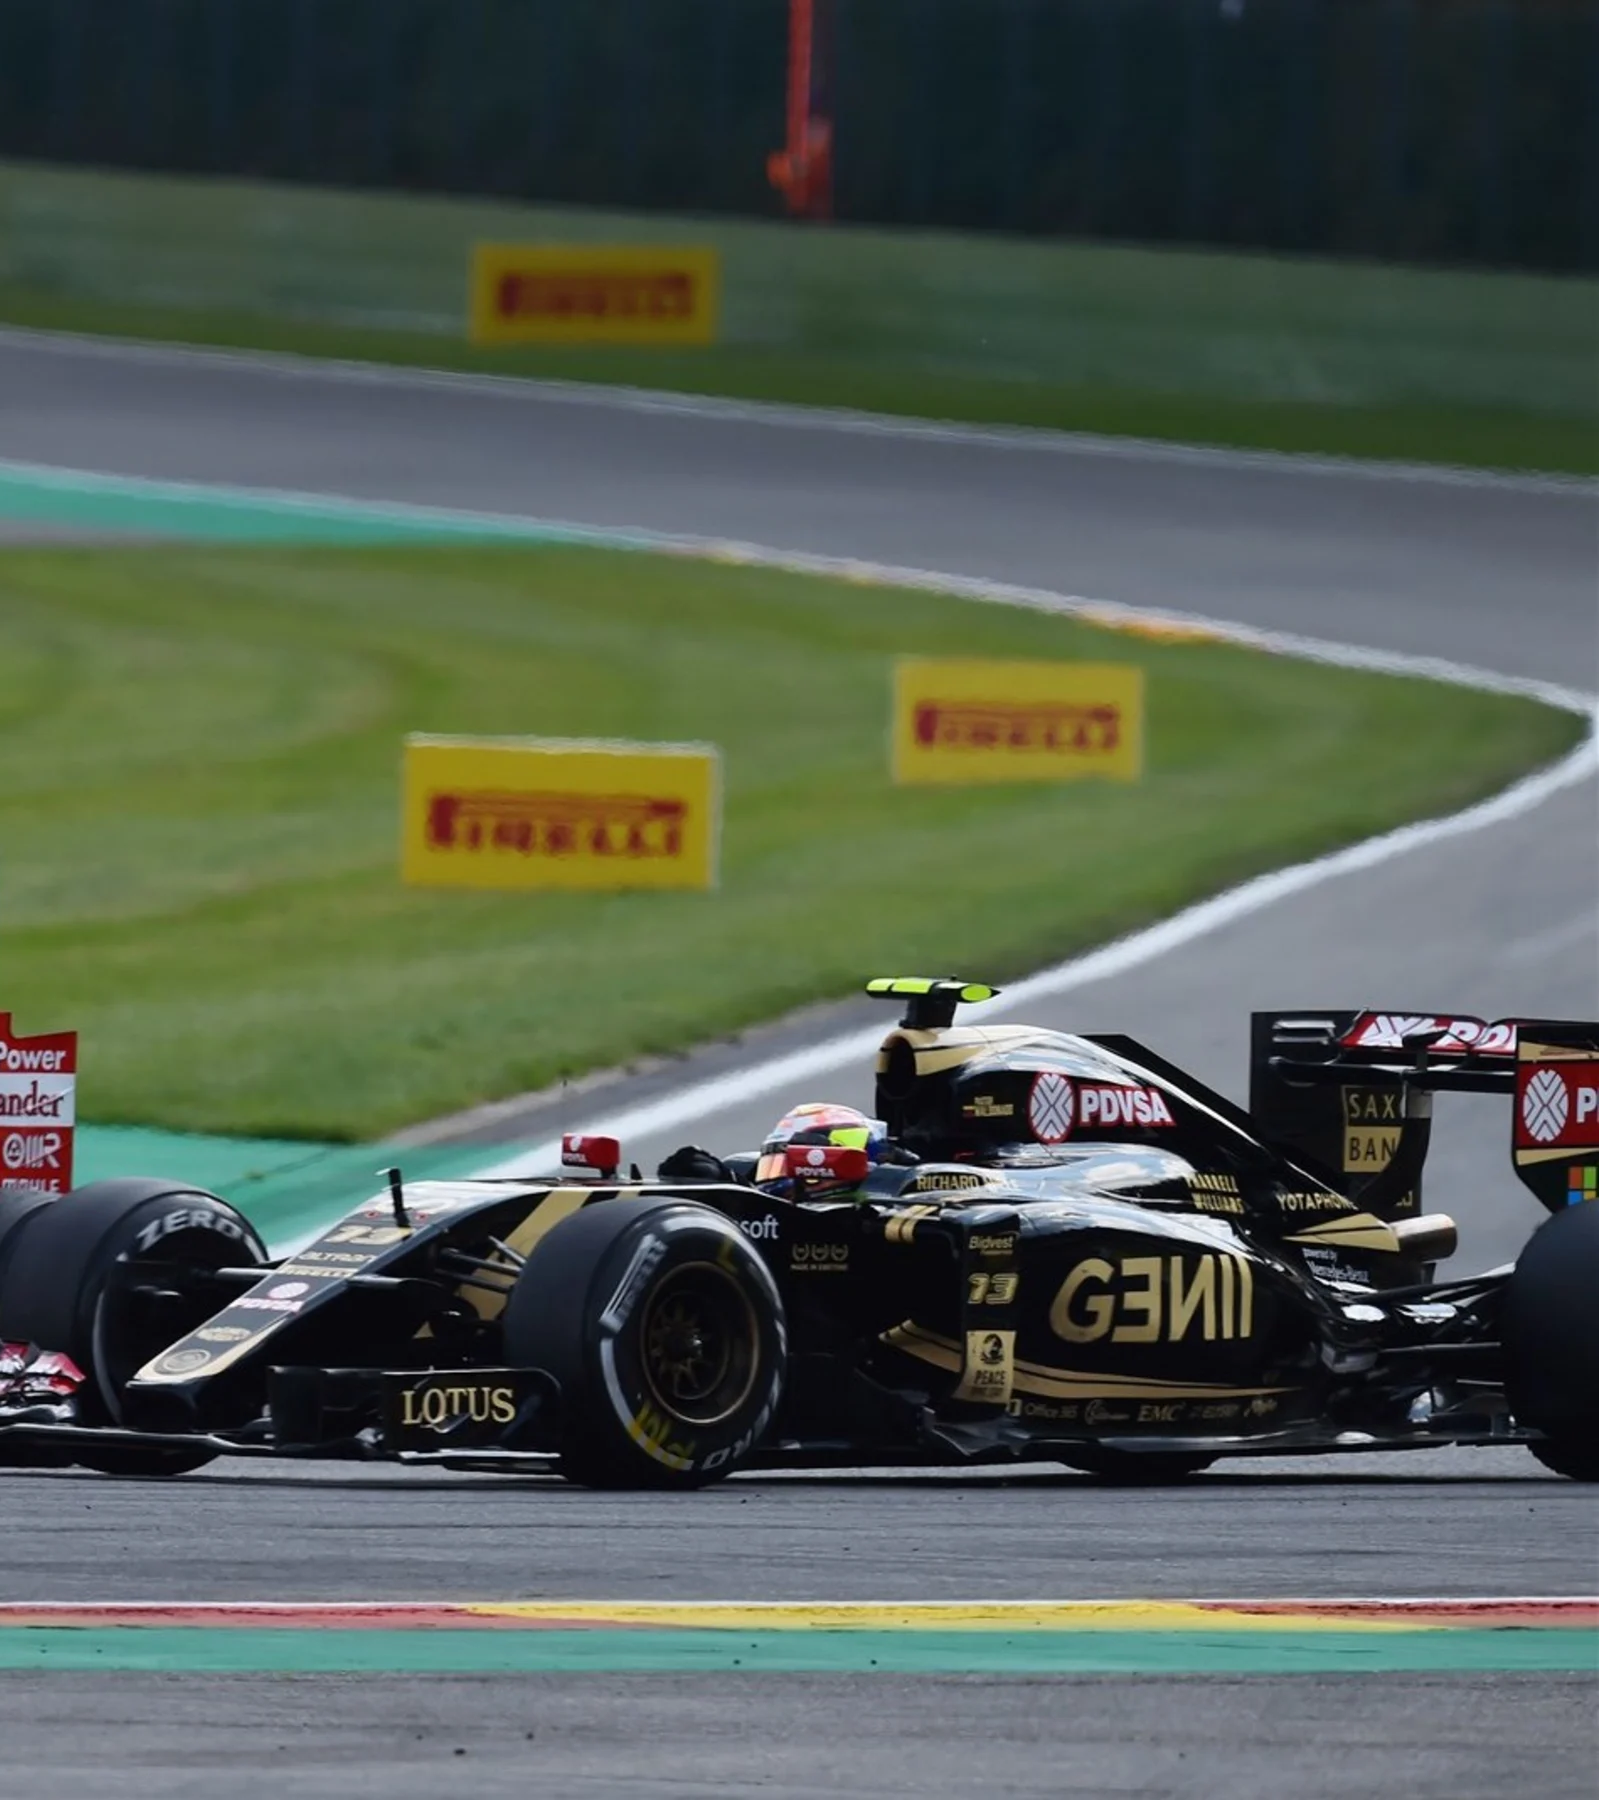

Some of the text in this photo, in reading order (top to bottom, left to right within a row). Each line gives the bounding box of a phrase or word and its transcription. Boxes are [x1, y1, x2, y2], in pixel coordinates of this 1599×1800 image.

[426, 788, 687, 857] PIRELLI
[1080, 1089, 1174, 1127] PDVSA
[916, 1175, 978, 1190] RICHARD
[136, 1208, 243, 1251] ZERO
[967, 1273, 1018, 1304] 13
[974, 1370, 1006, 1385] PEACE
[402, 1387, 516, 1423] LOTUS
